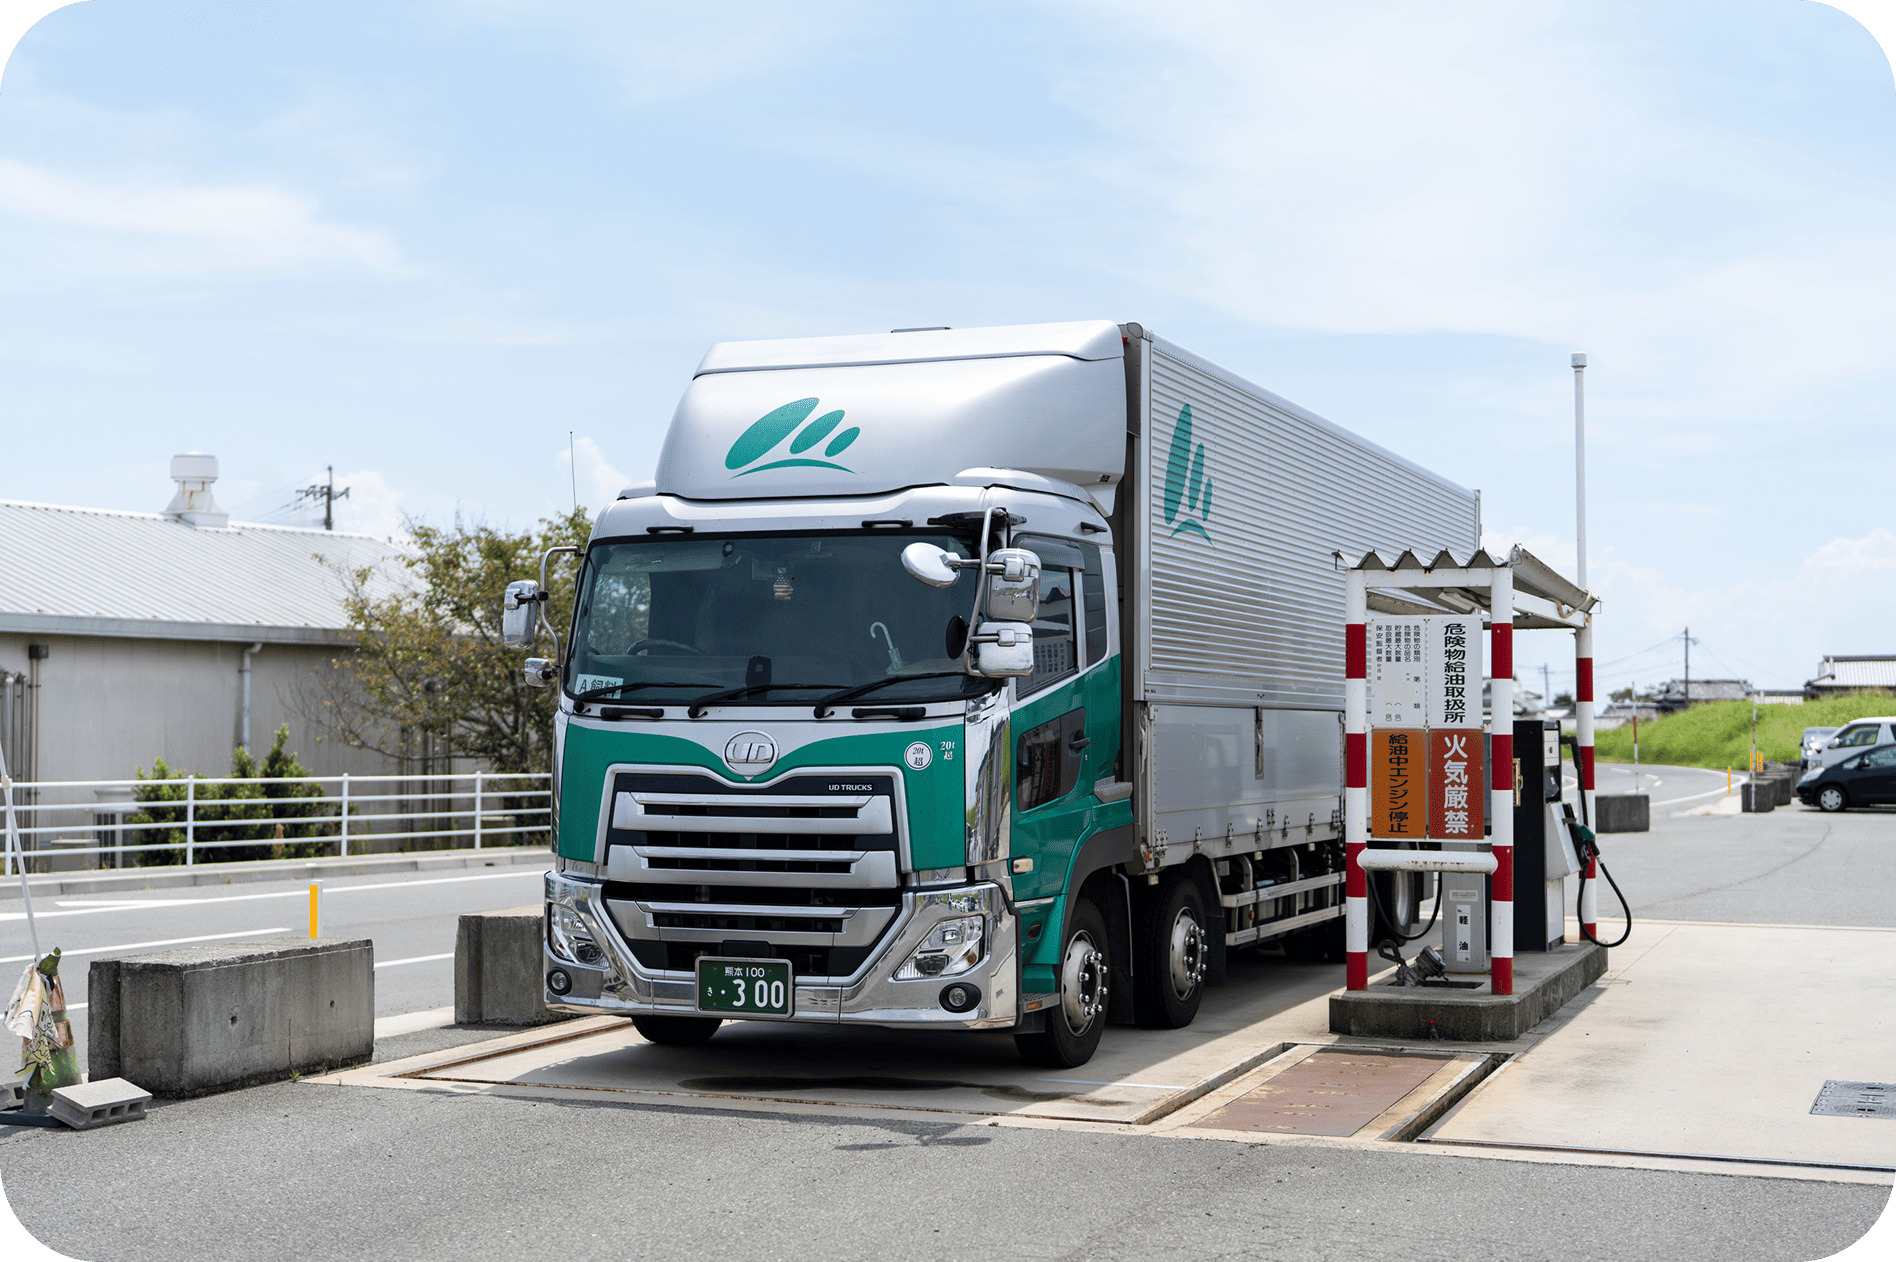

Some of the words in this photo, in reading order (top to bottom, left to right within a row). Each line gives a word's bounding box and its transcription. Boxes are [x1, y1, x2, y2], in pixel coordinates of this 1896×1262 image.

[1444, 623, 1466, 723] 危険物給油取扱所
[726, 742, 774, 763] UD
[1389, 734, 1408, 833] 給油中エンジン停止
[1444, 734, 1468, 834] 火気厳禁
[1459, 915, 1468, 951] 軽油
